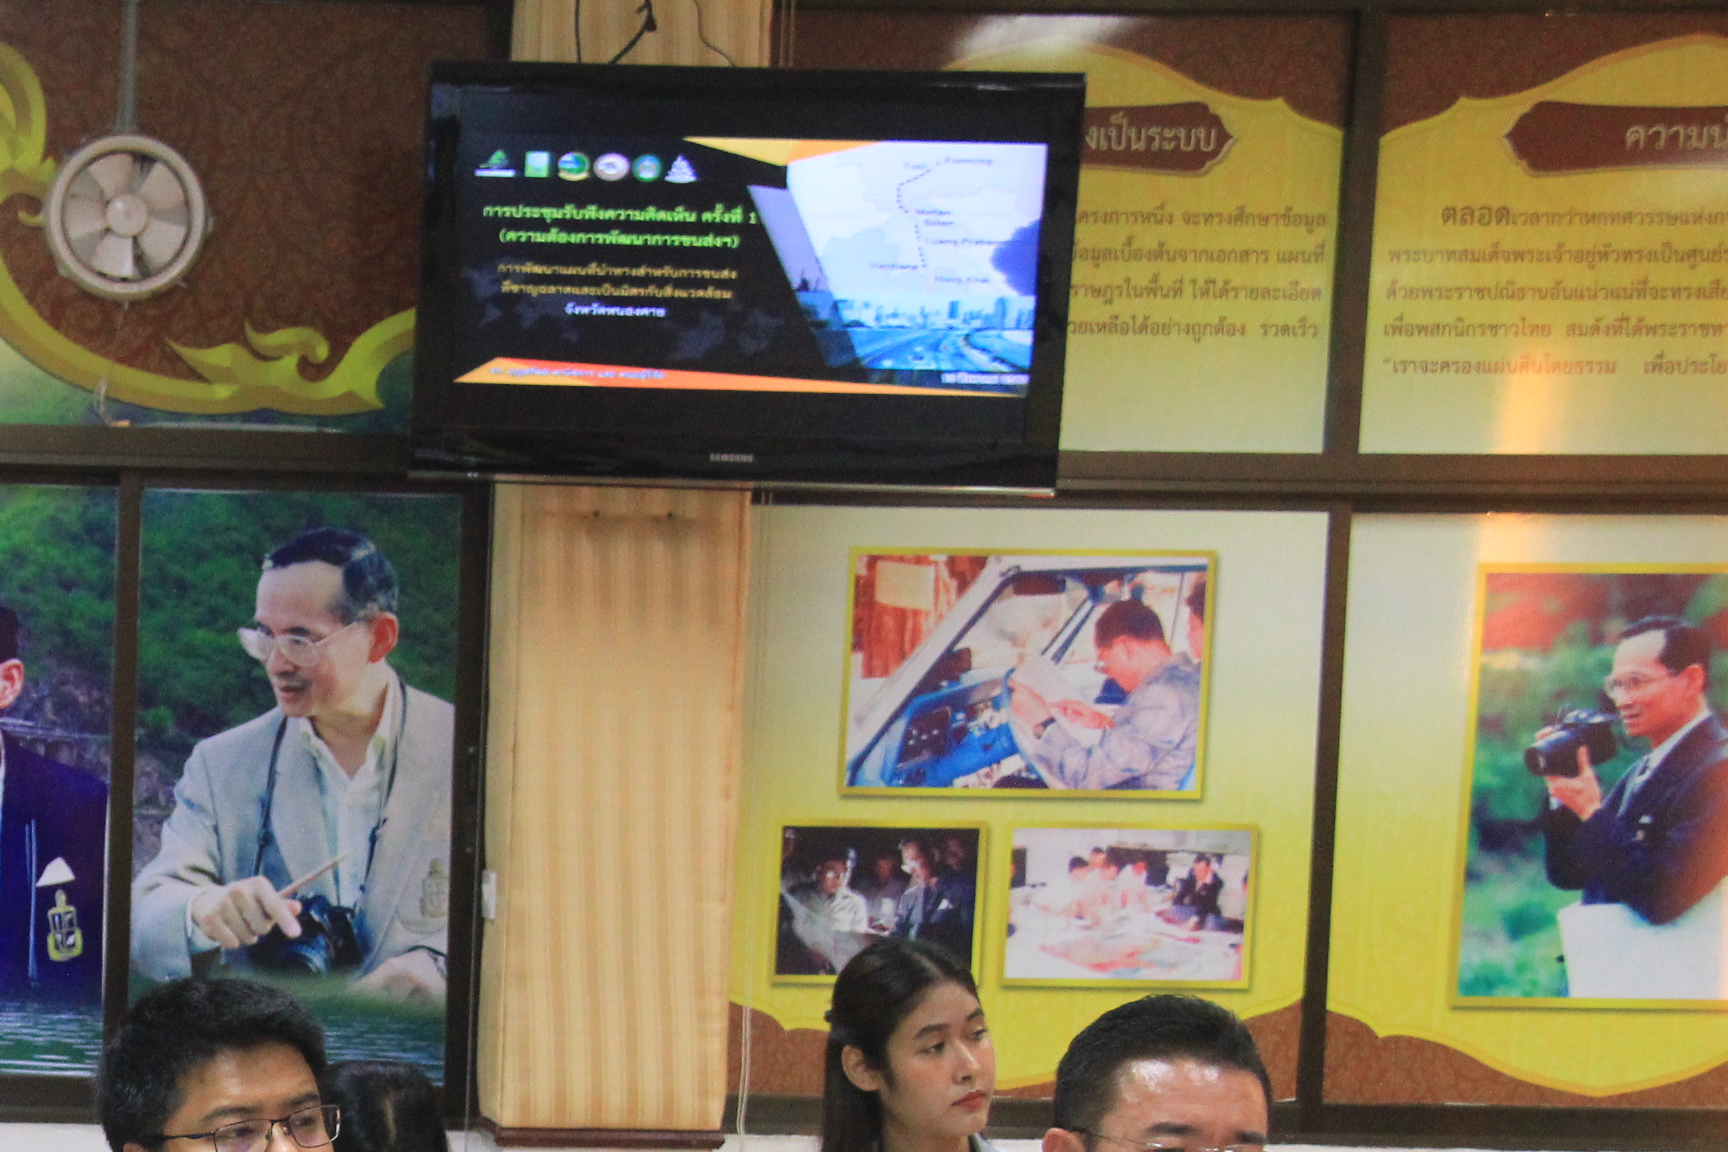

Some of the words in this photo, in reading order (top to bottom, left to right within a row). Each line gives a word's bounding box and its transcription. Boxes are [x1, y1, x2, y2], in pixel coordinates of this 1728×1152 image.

[1625, 113, 1728, 150] ความน
[482, 204, 697, 223] การประชุมรับฟังความคิดเห็น
[701, 203, 744, 224] ครั้งที่
[748, 211, 759, 225] 1
[1275, 239, 1326, 264] แผนที่
